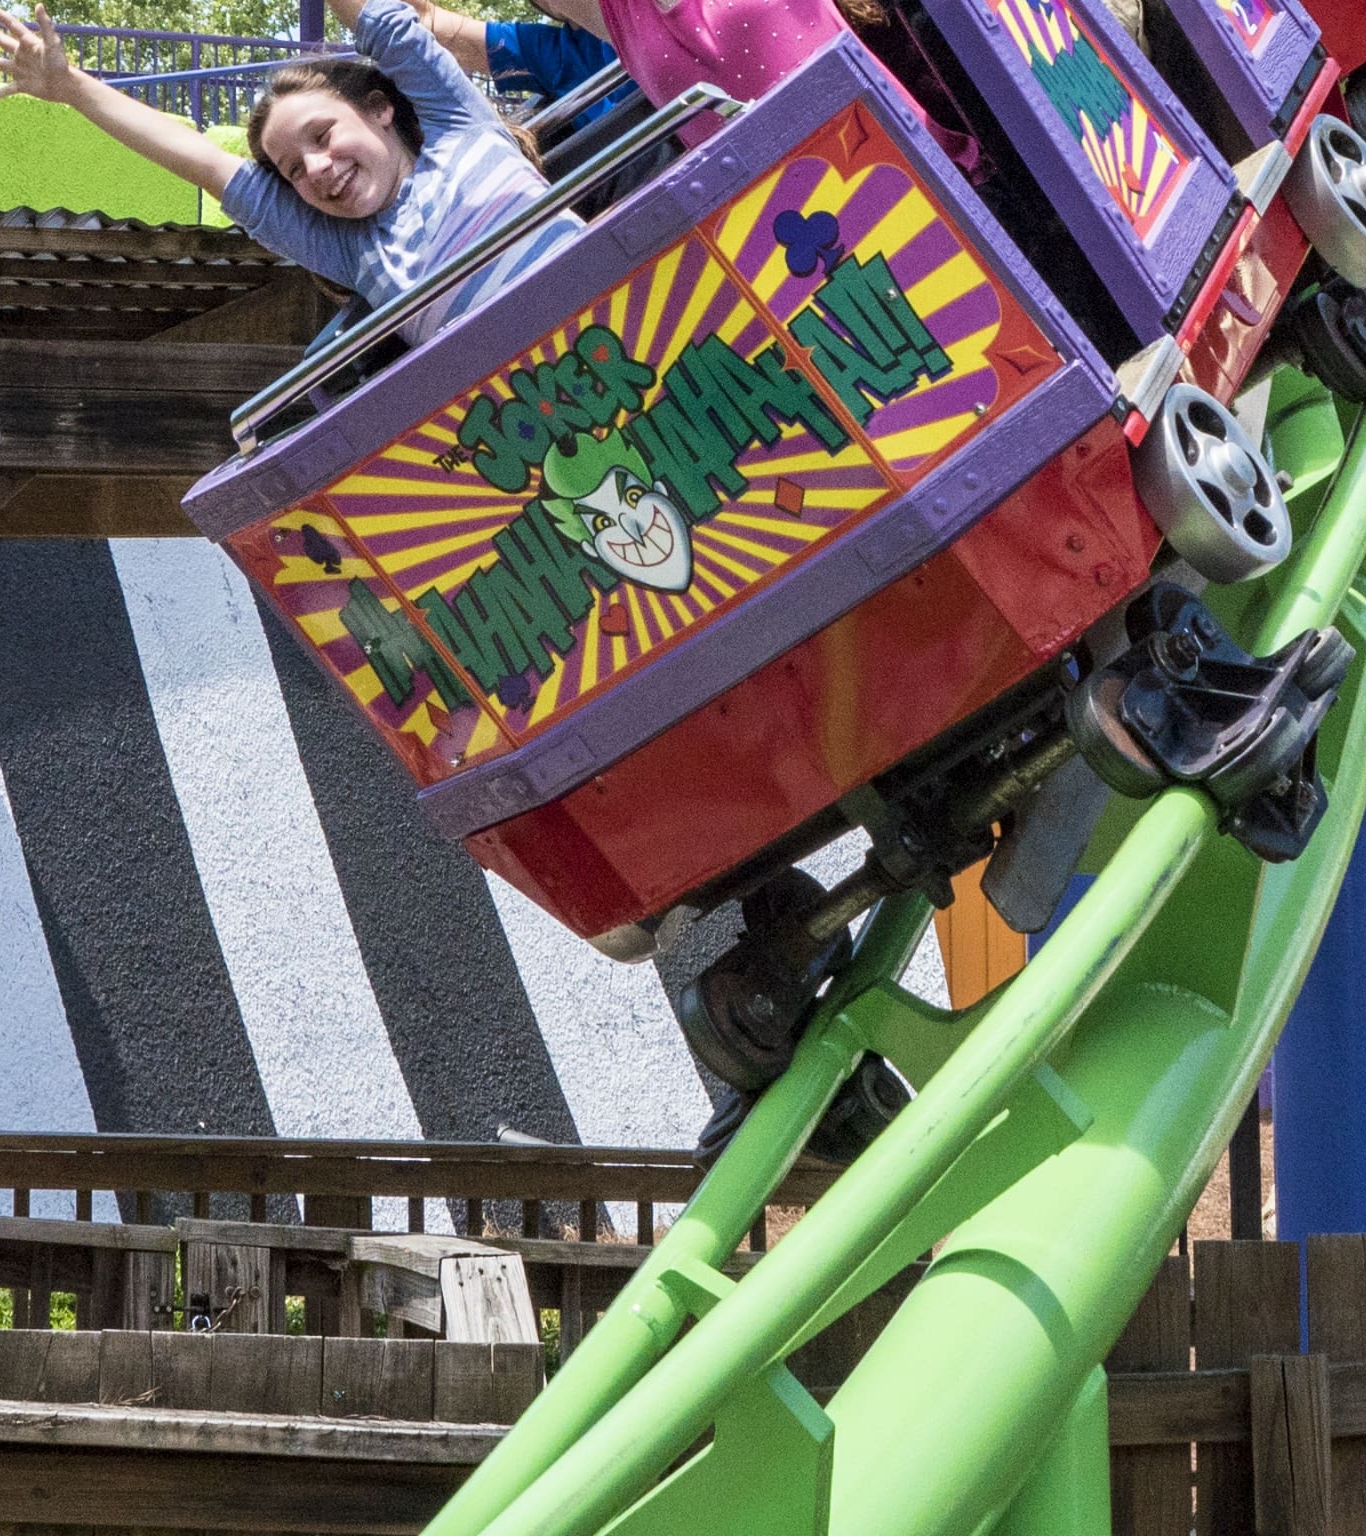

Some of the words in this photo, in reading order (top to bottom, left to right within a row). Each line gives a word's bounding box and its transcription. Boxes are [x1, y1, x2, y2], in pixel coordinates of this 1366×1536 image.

[1231, 0, 1257, 35] 2
[432, 443, 469, 474] THE
[456, 323, 658, 494] JOKER
